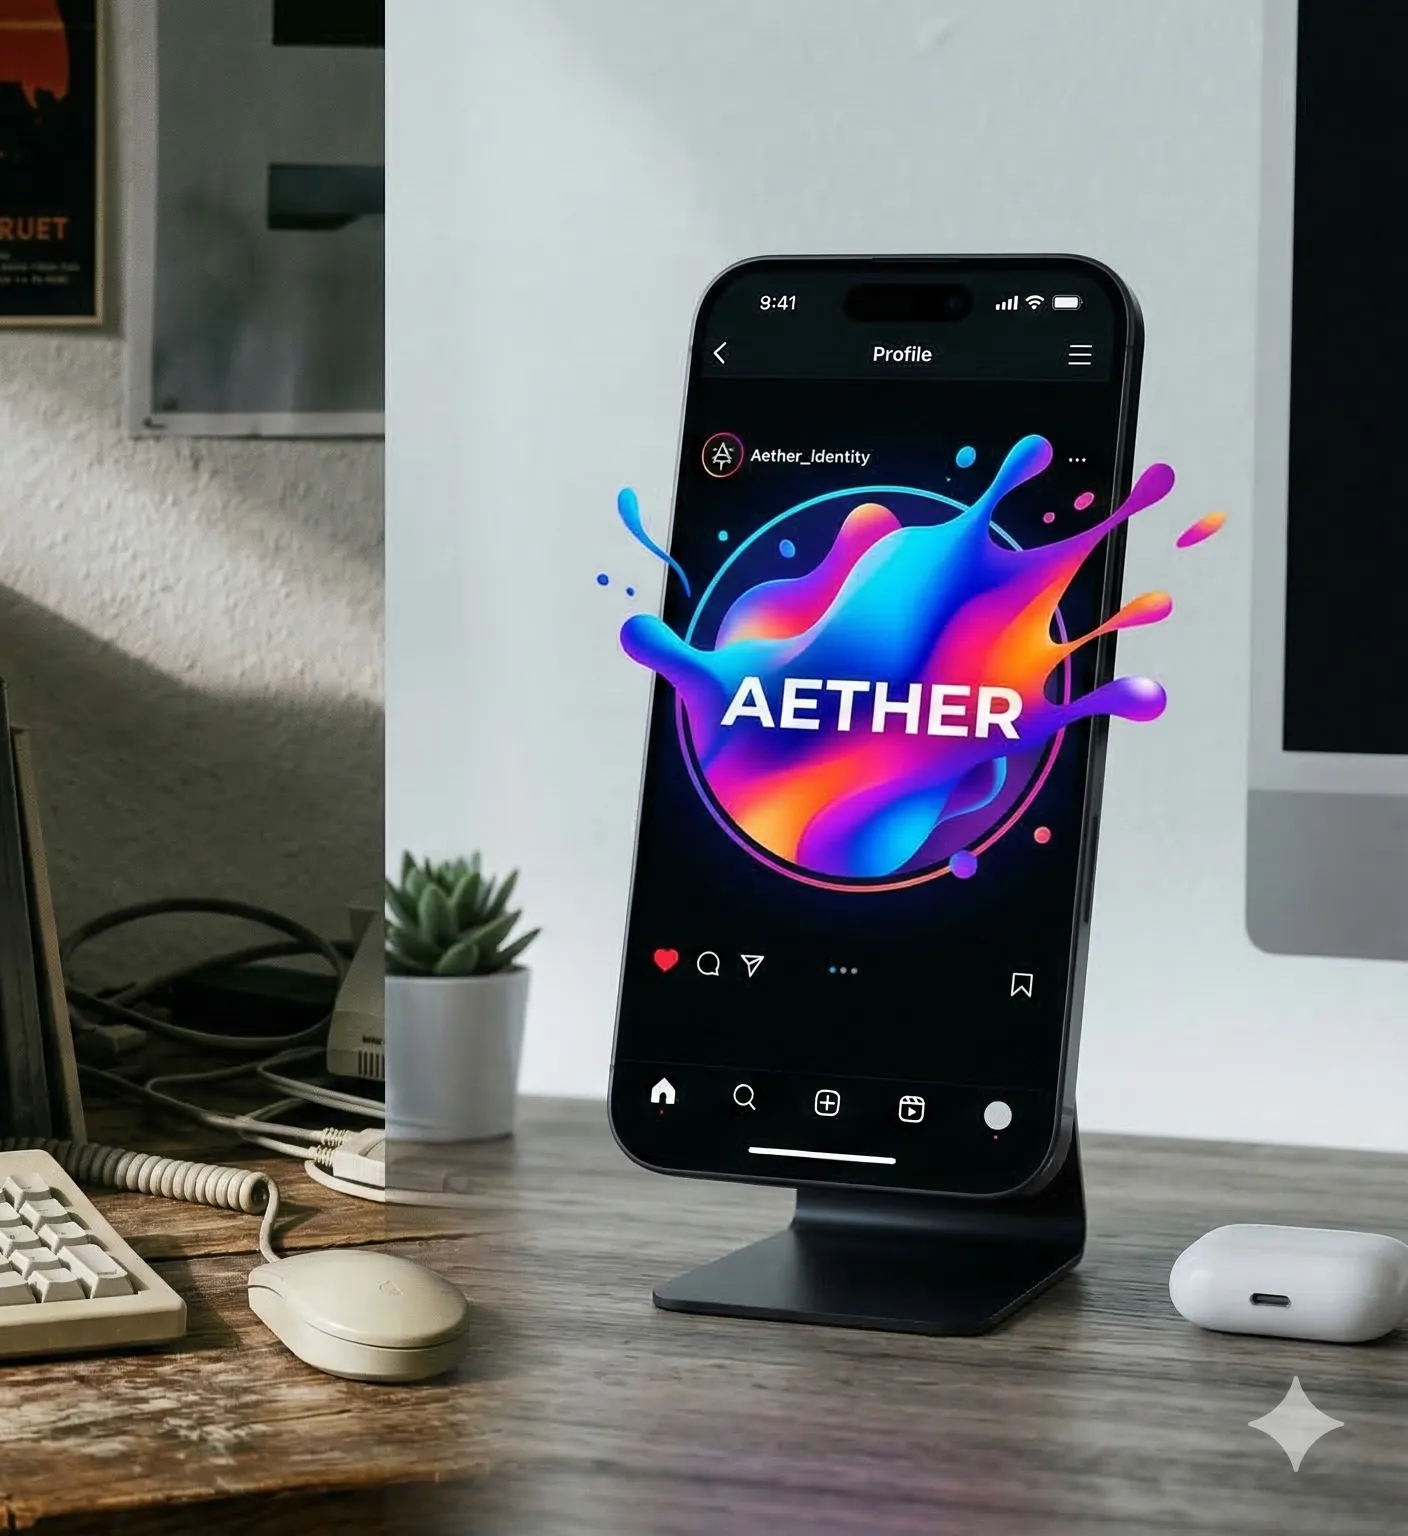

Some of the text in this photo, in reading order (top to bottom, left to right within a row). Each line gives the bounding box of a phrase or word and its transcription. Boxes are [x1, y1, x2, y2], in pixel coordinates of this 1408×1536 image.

[759, 295, 796, 311] 9:41
[873, 346, 933, 363] Profile
[750, 448, 870, 467] Aether_Identity
[720, 676, 1023, 740] AETHER
